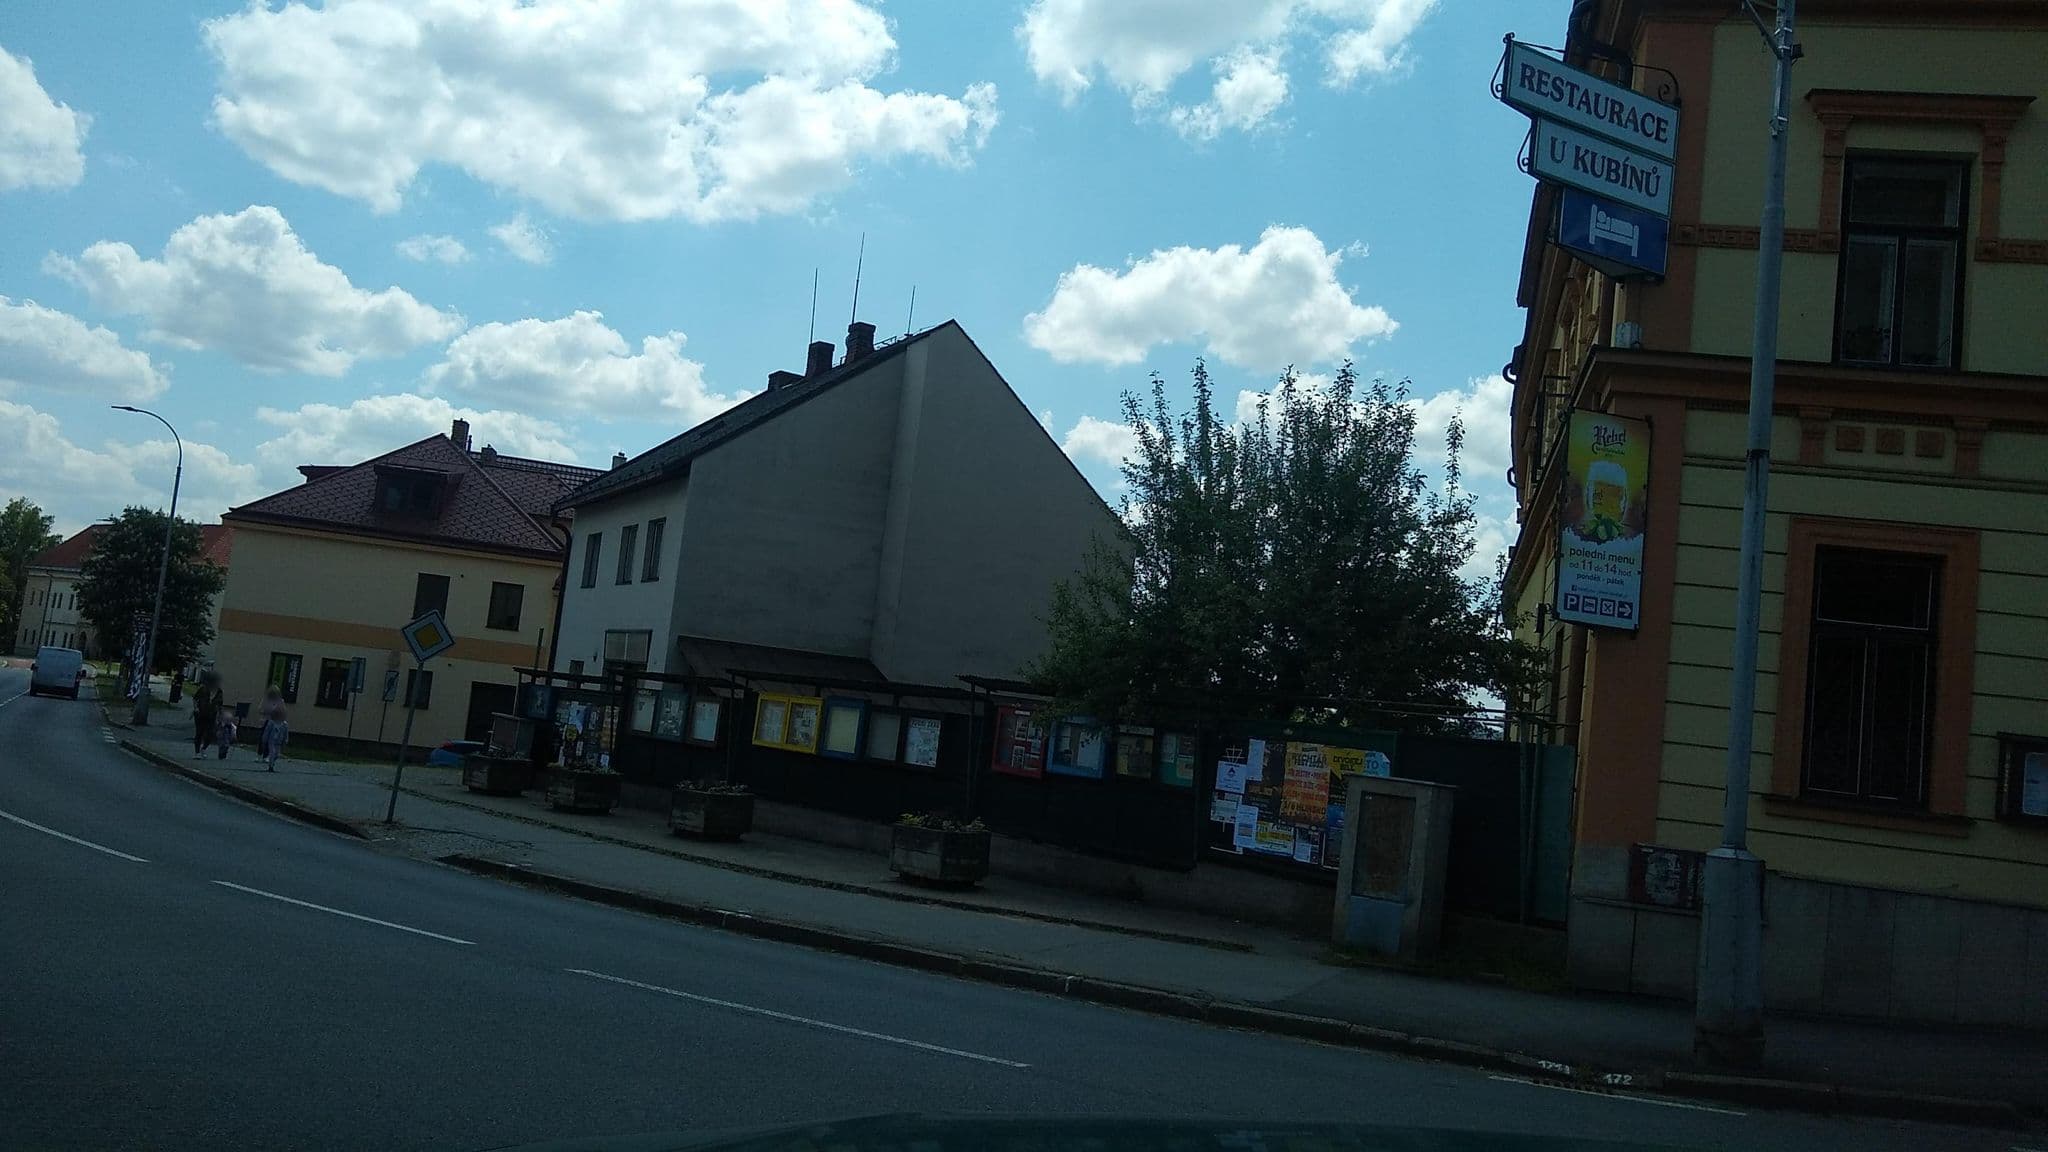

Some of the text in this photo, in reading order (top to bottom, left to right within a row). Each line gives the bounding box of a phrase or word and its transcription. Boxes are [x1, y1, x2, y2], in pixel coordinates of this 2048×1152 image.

[1519, 62, 1669, 144] RESTAURACE
[1550, 136, 1661, 198] U KUBÍNŮ
[1569, 547, 1635, 565] polední menu
[1582, 559, 1593, 571] 11
[1604, 562, 1617, 575] 14
[1605, 1073, 1633, 1086] 172
